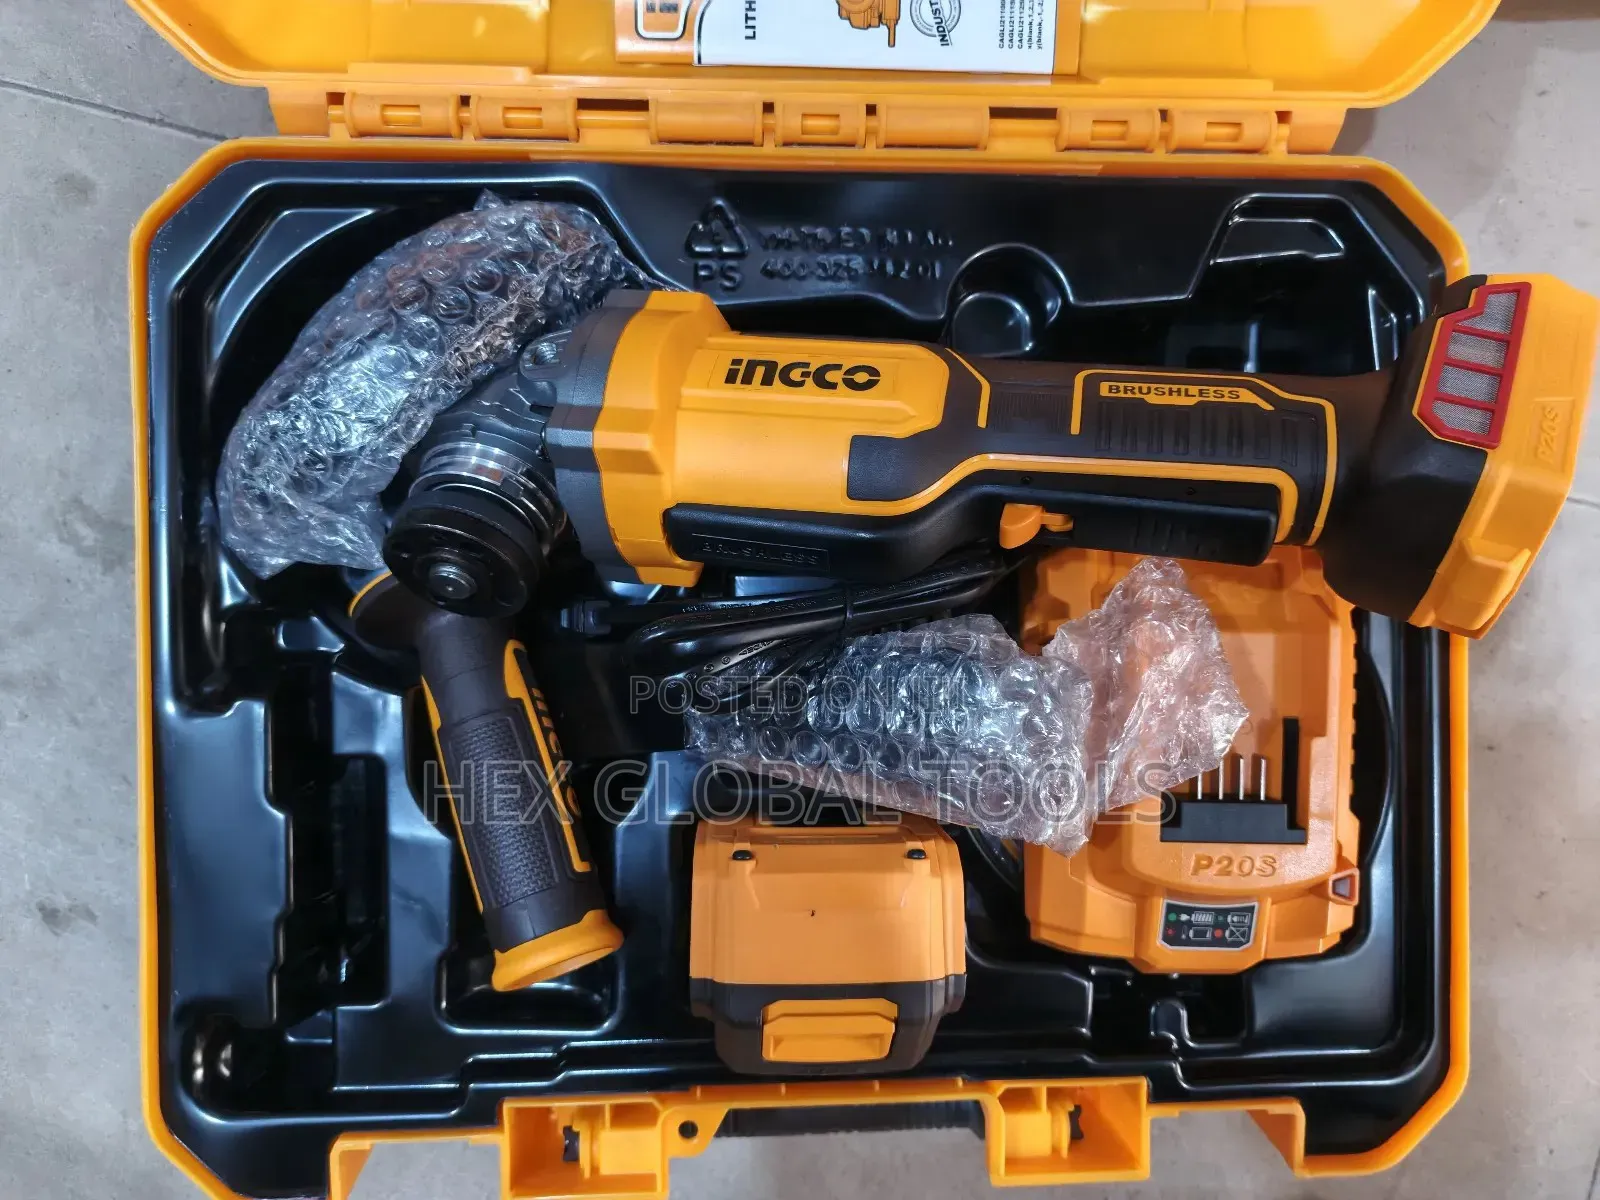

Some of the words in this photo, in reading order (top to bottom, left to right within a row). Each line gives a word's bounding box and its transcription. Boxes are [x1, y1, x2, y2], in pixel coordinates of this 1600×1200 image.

[693, 262, 741, 291] PS
[1107, 384, 1241, 400] BRUSHLESS
[1190, 853, 1278, 878] P20S
